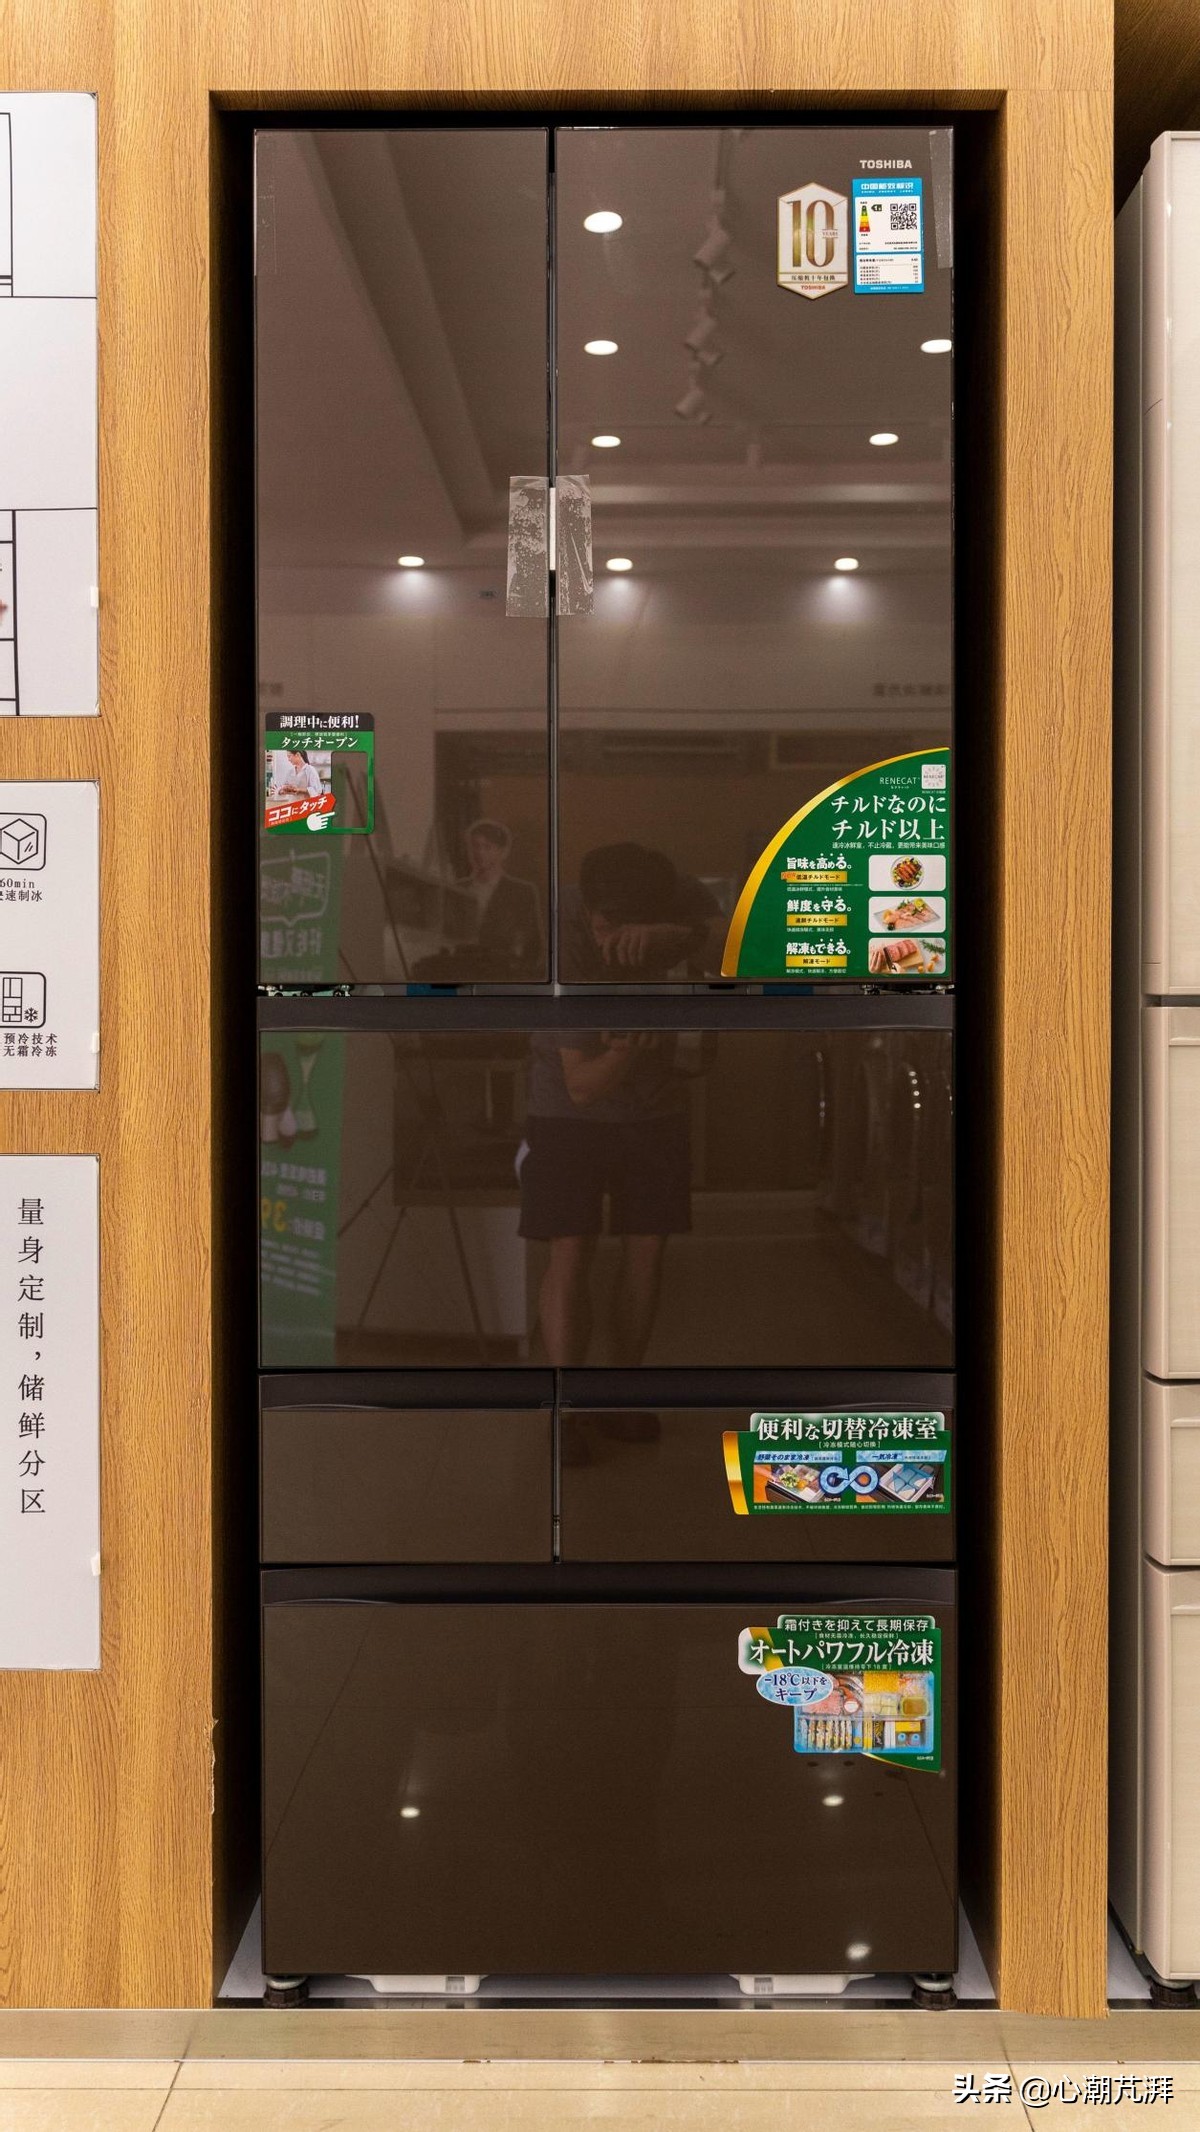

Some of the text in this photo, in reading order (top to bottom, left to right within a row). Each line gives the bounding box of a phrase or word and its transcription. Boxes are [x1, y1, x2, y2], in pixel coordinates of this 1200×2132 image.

[860, 159, 912, 169] TOSHIBA
[786, 199, 835, 268] 10
[280, 715, 360, 729] 調理中に便利!
[281, 737, 358, 749] タッチオープン
[268, 796, 328, 822] ココにタッチ
[831, 795, 947, 814] チルドなのに
[831, 818, 945, 841] チルド以上
[786, 856, 852, 870] 旨味を高める。
[786, 899, 852, 912] 鮮度を守る。
[786, 942, 852, 955] 解凍もできる。
[4, 1033, 58, 1045] 预冷技术
[3, 1045, 57, 1057] 无霜冷冻
[757, 1418, 938, 1441] 便利な切替冷凍室
[784, 1619, 929, 1632] 霜付きを抑えて長期保存
[750, 1638, 934, 1666] オートパワフル冷凍
[775, 1688, 817, 1701] キープ
